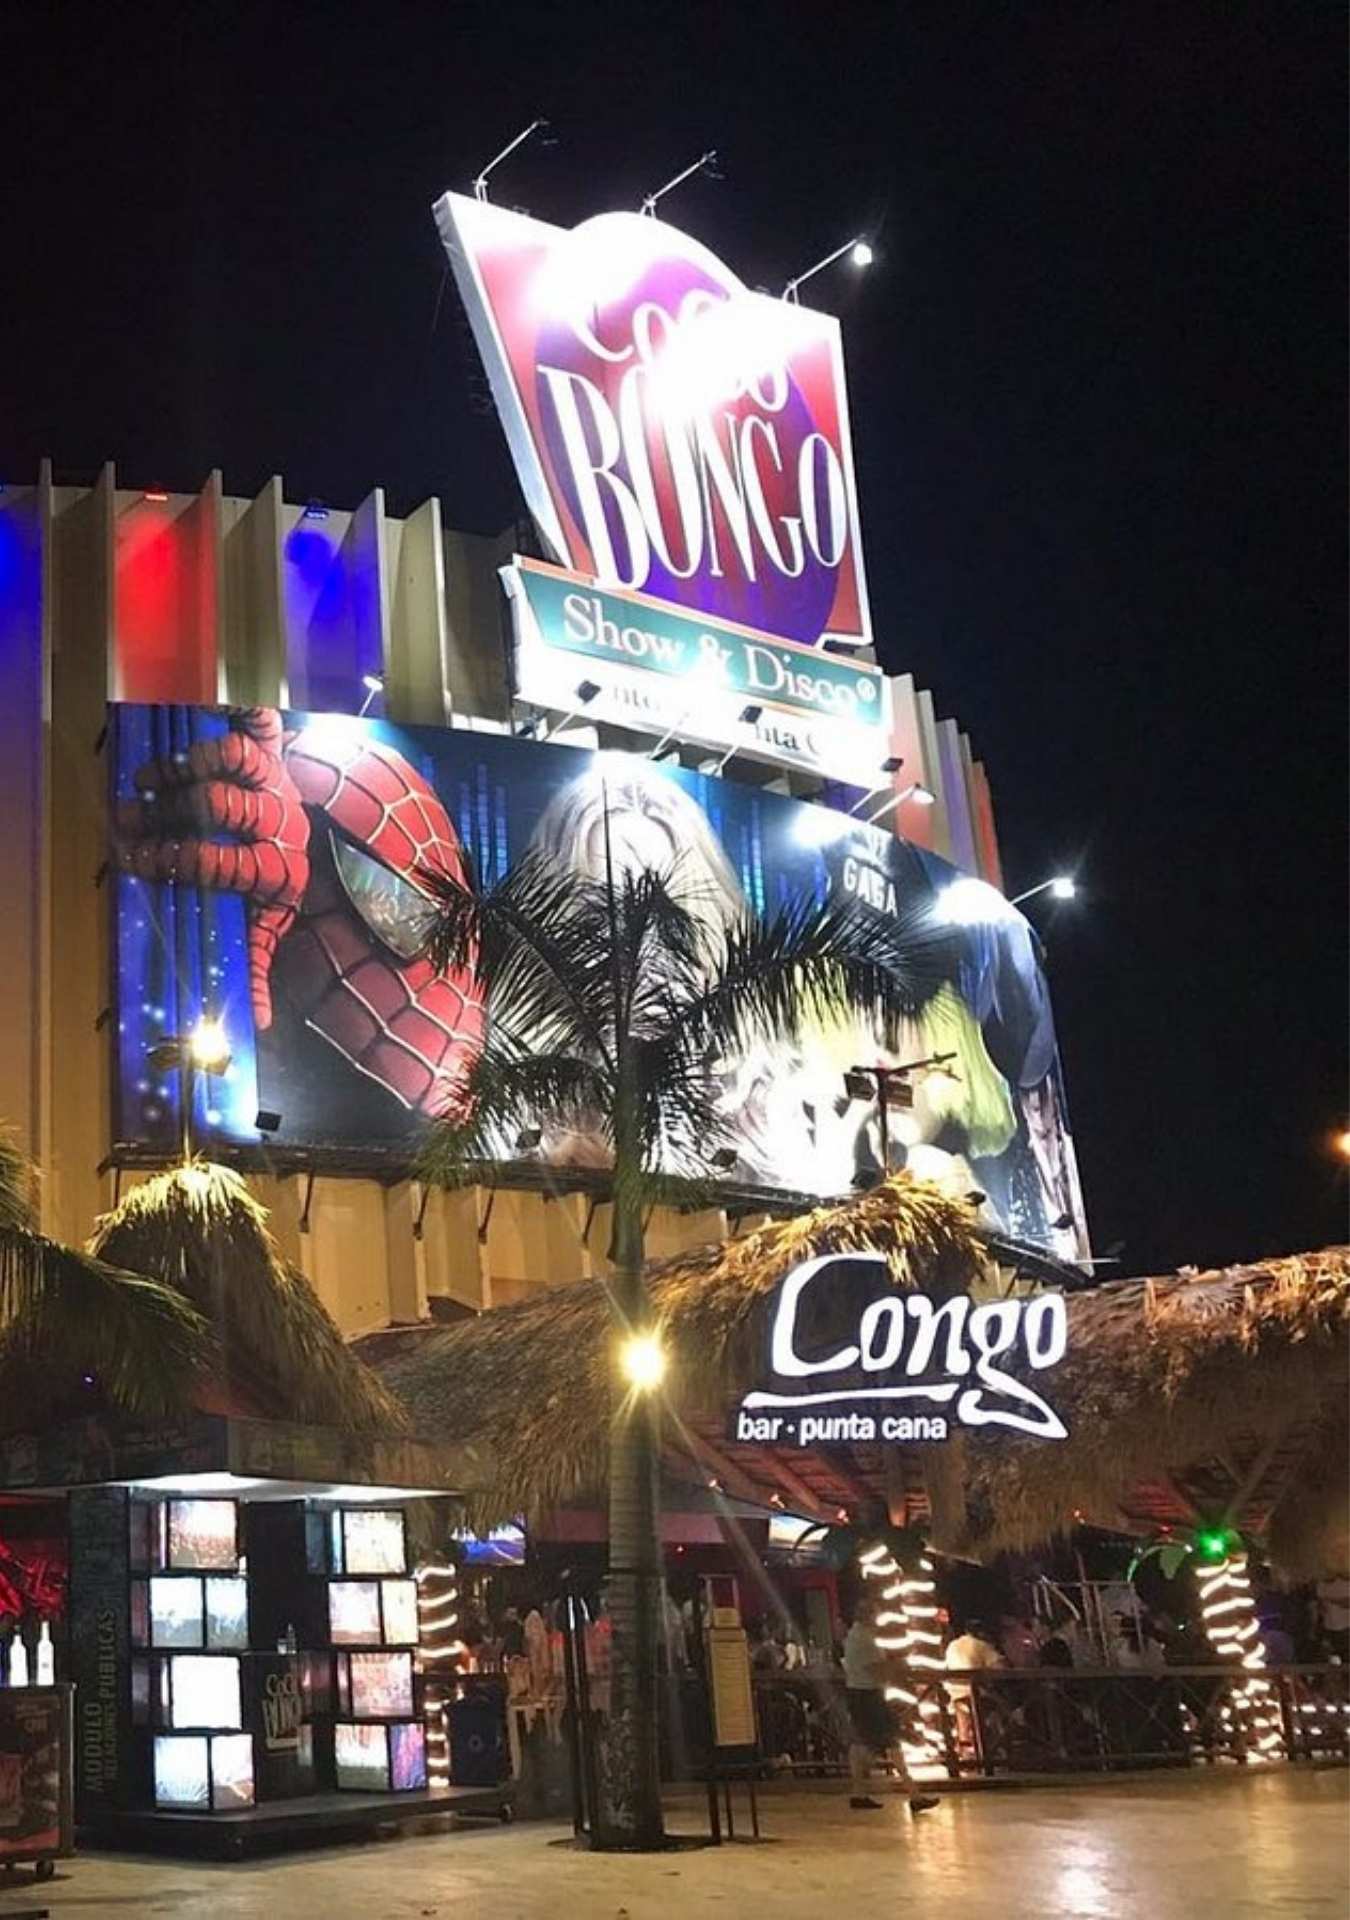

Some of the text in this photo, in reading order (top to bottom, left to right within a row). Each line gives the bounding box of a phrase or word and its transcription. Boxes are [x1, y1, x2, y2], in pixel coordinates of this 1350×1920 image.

[537, 362, 848, 588] BONGO
[562, 593, 682, 664] Show
[772, 1250, 1069, 1439] Congo
[737, 1411, 947, 1446] bar punta cana
